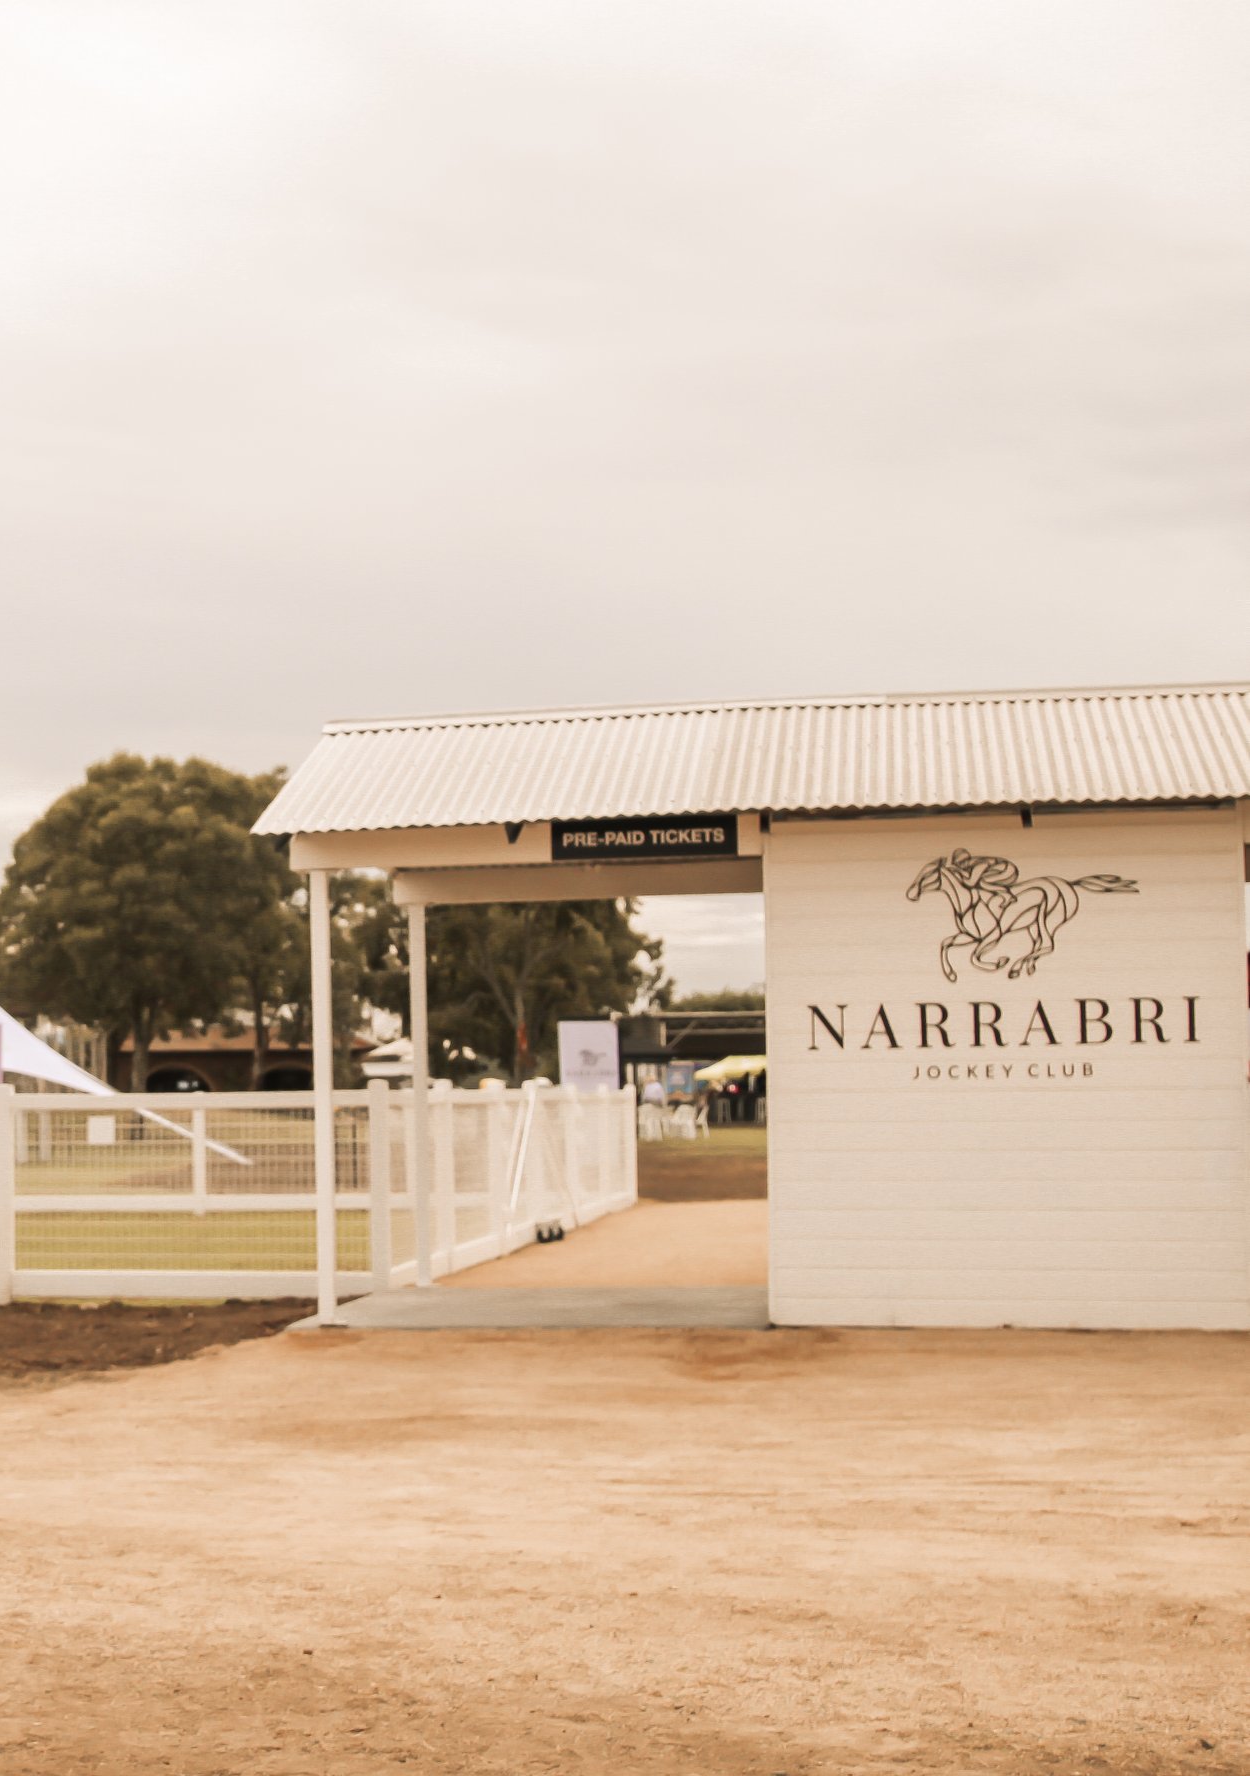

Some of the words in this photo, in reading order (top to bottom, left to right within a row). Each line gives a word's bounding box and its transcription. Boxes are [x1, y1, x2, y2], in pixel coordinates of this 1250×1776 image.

[562, 831, 645, 848] PRE-PAID
[650, 827, 725, 845] TICKETS
[807, 996, 1201, 1051] NARRABRI
[913, 1064, 1014, 1080] JOCKEY
[1028, 1062, 1094, 1078] CLUB
